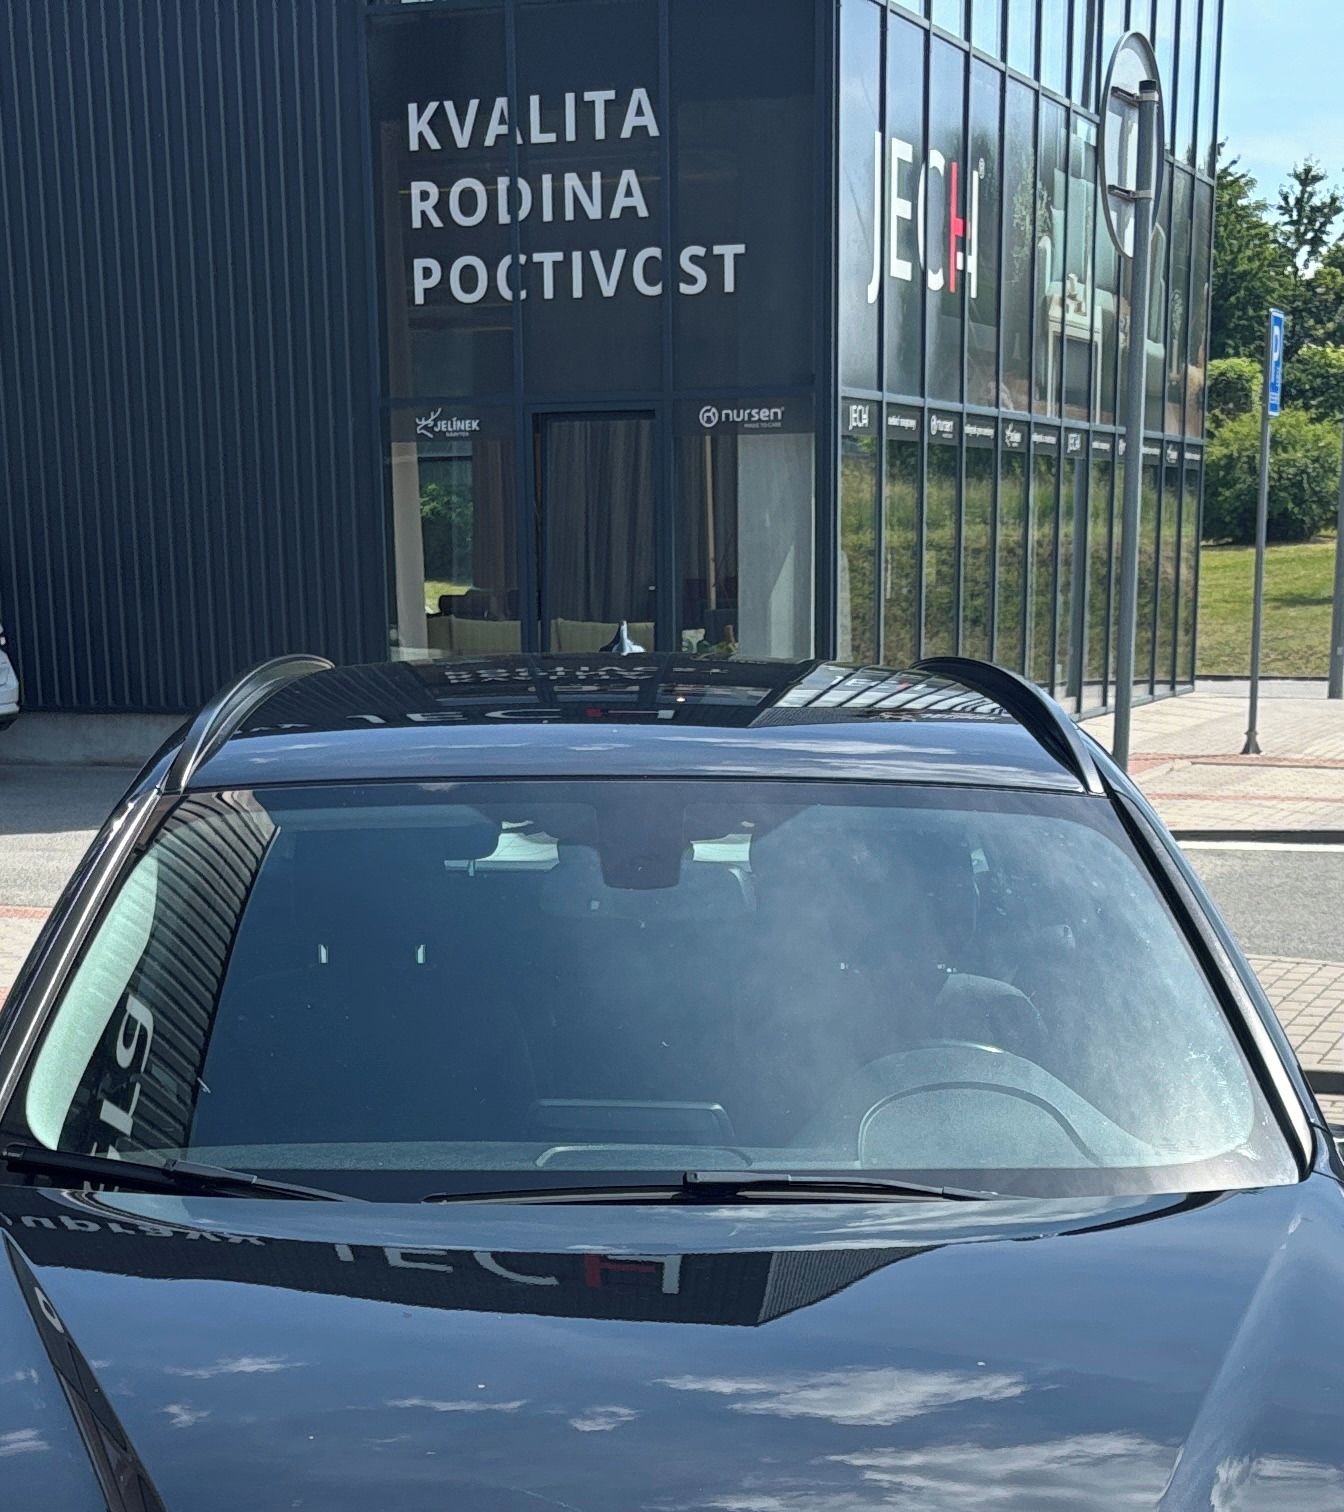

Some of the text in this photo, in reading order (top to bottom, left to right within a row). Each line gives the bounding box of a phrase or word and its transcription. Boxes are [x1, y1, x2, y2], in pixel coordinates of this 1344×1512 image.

[408, 88, 660, 151] KVALITA
[411, 169, 649, 228] RODINA
[867, 130, 979, 304] JECH
[721, 408, 782, 421] nursen
